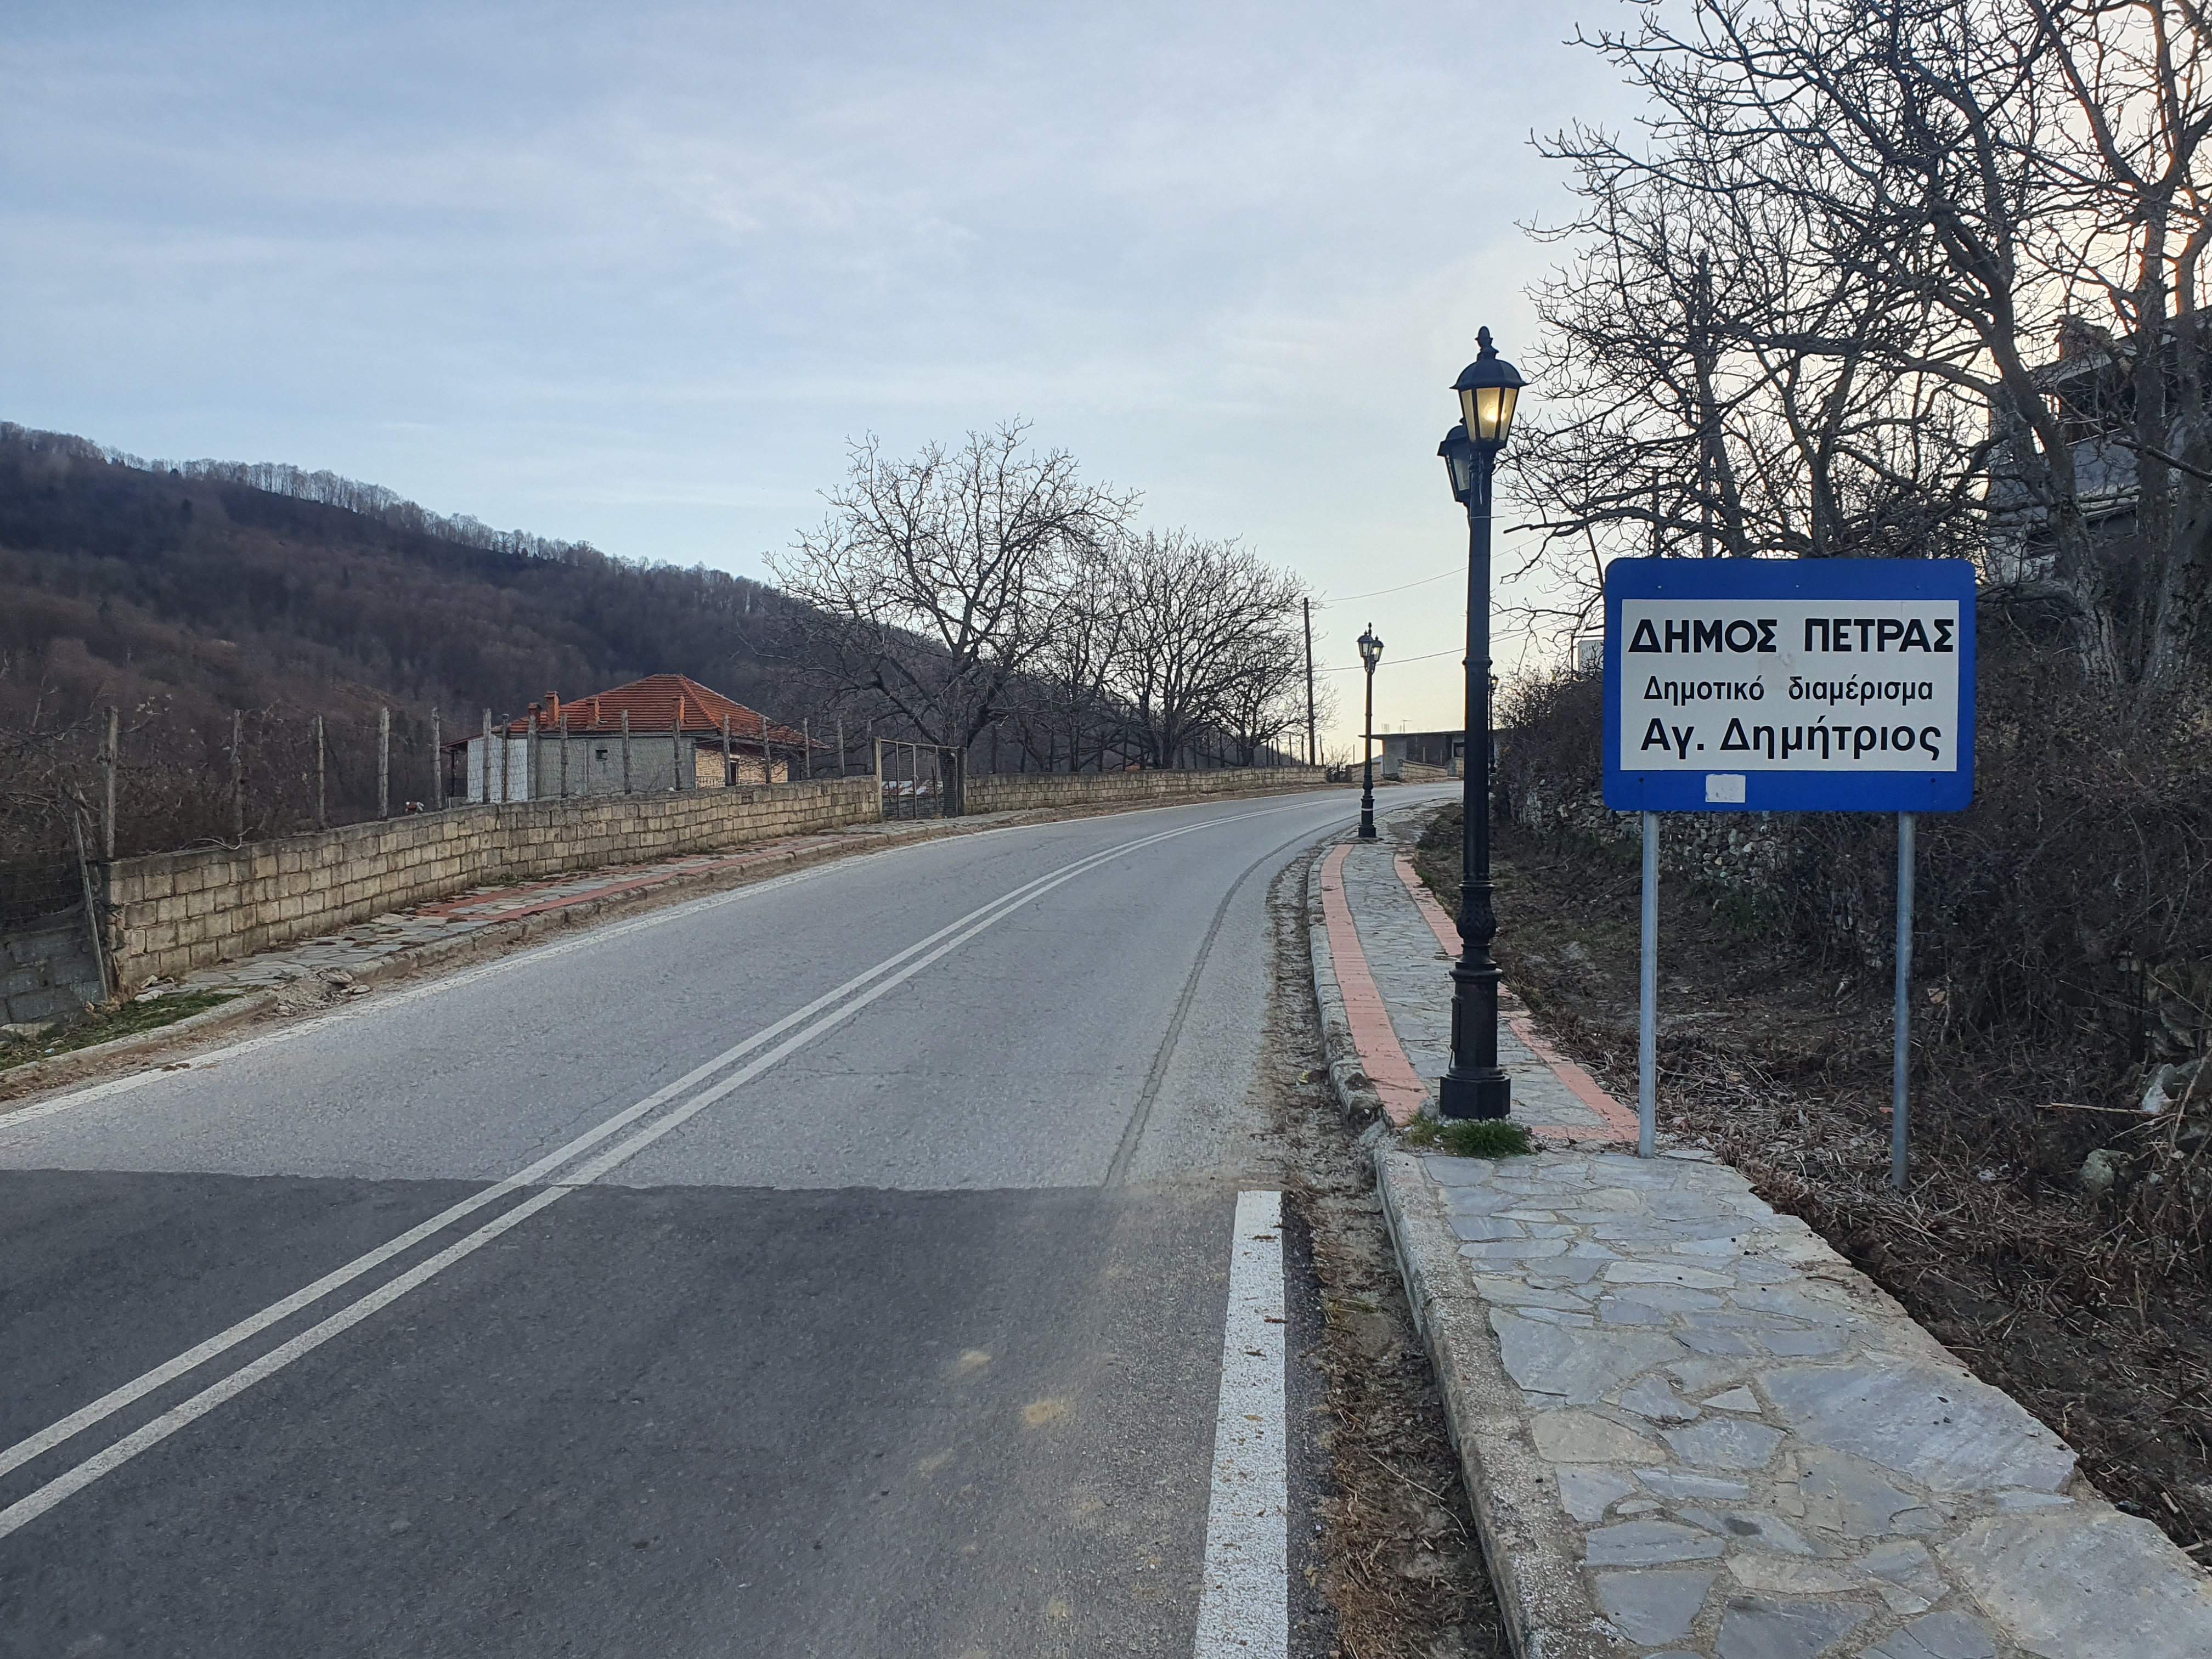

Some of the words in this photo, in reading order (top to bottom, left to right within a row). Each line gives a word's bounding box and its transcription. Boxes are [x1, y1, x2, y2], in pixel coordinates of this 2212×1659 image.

[1628, 619, 1777, 653] ΔΗΜΟΣ
[1805, 618, 1954, 652] ΠΕΤΡΑΣ
[1644, 675, 1764, 706] Δημοτικό
[1789, 674, 1932, 706] διαμέρισμα
[1641, 718, 1703, 759] Αγ.
[1720, 715, 1941, 760] Δημήτριος
